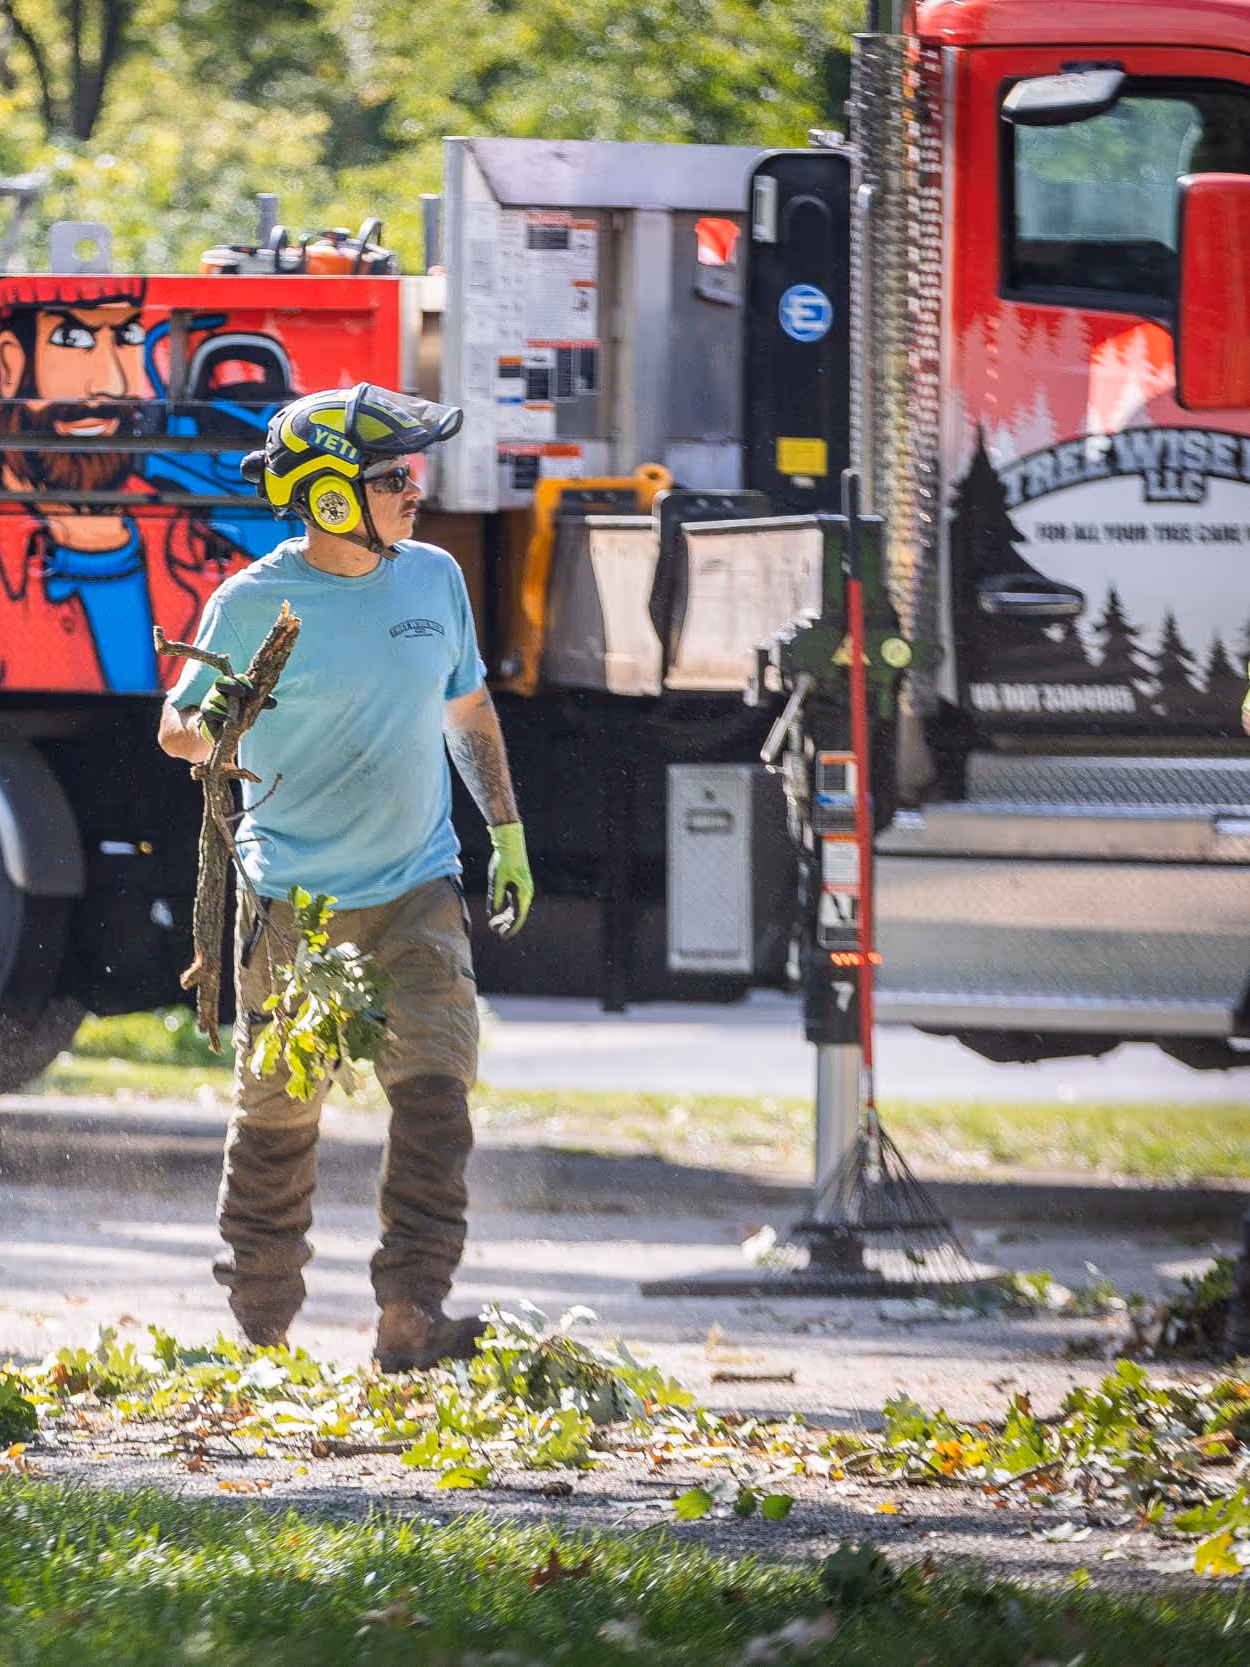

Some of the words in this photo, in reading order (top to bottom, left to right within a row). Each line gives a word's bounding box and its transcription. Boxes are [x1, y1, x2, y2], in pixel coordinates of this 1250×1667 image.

[314, 428, 358, 459] YETI
[1001, 434, 1113, 506] TREE
[1111, 428, 1239, 475] WISE
[1146, 469, 1207, 500] LLC
[1036, 522, 1067, 541] FOR
[1072, 522, 1100, 541] ALL
[1104, 522, 1149, 541] YOUR
[1152, 522, 1192, 541] TREE
[1197, 522, 1240, 541] CARE
[830, 981, 855, 1012] 7
